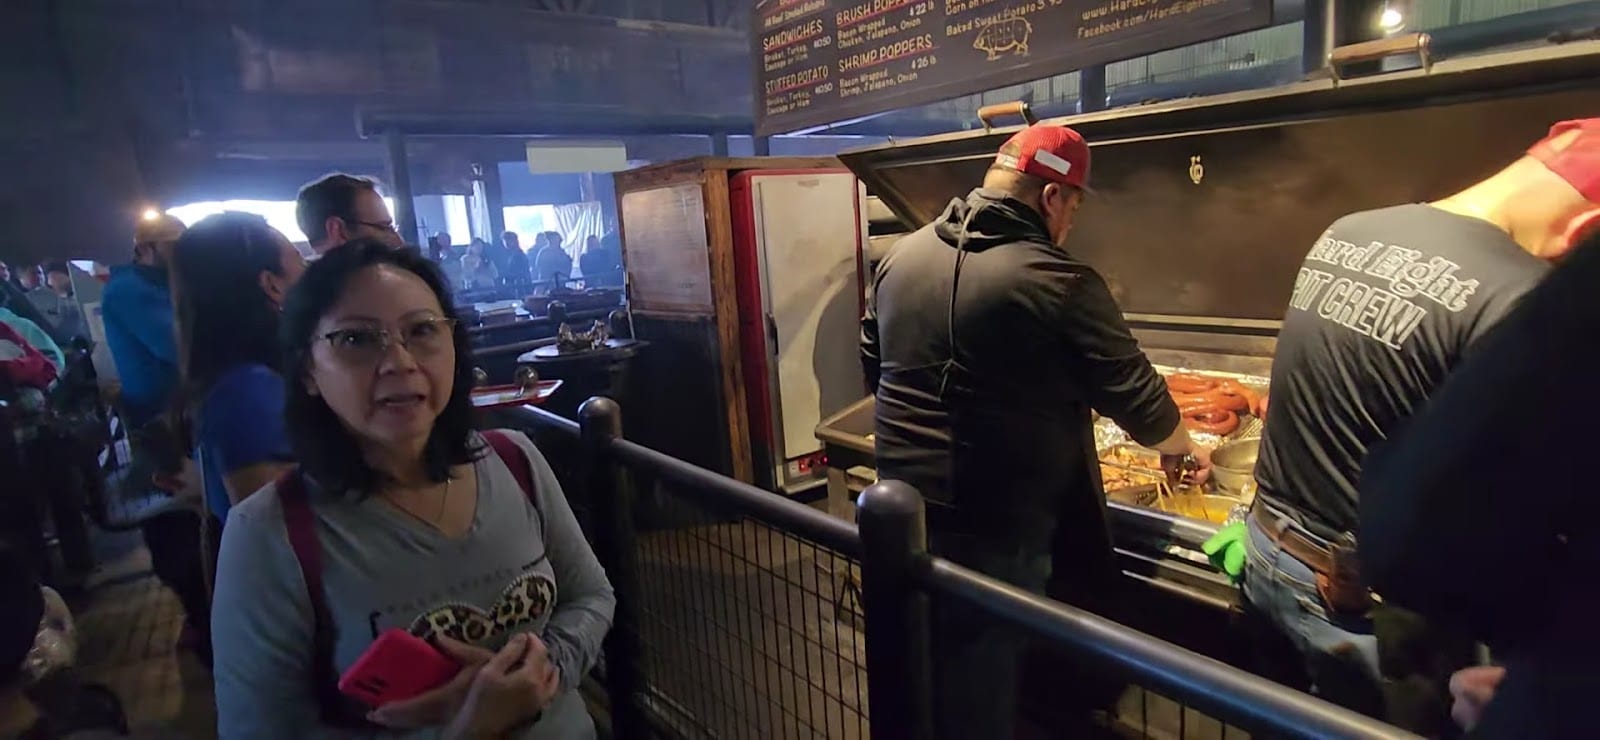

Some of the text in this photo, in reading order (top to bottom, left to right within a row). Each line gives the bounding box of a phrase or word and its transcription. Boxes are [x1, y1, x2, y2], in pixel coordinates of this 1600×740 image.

[836, 1, 871, 25] BRUSH
[945, 2, 967, 16] Corn
[763, 19, 823, 50] SANDWICHES
[946, 20, 973, 36] Baked
[838, 34, 933, 72] SHRIMP POPPERS
[797, 65, 829, 84] POTATO
[1305, 232, 1384, 272] ard
[1317, 277, 1428, 351] CREW
